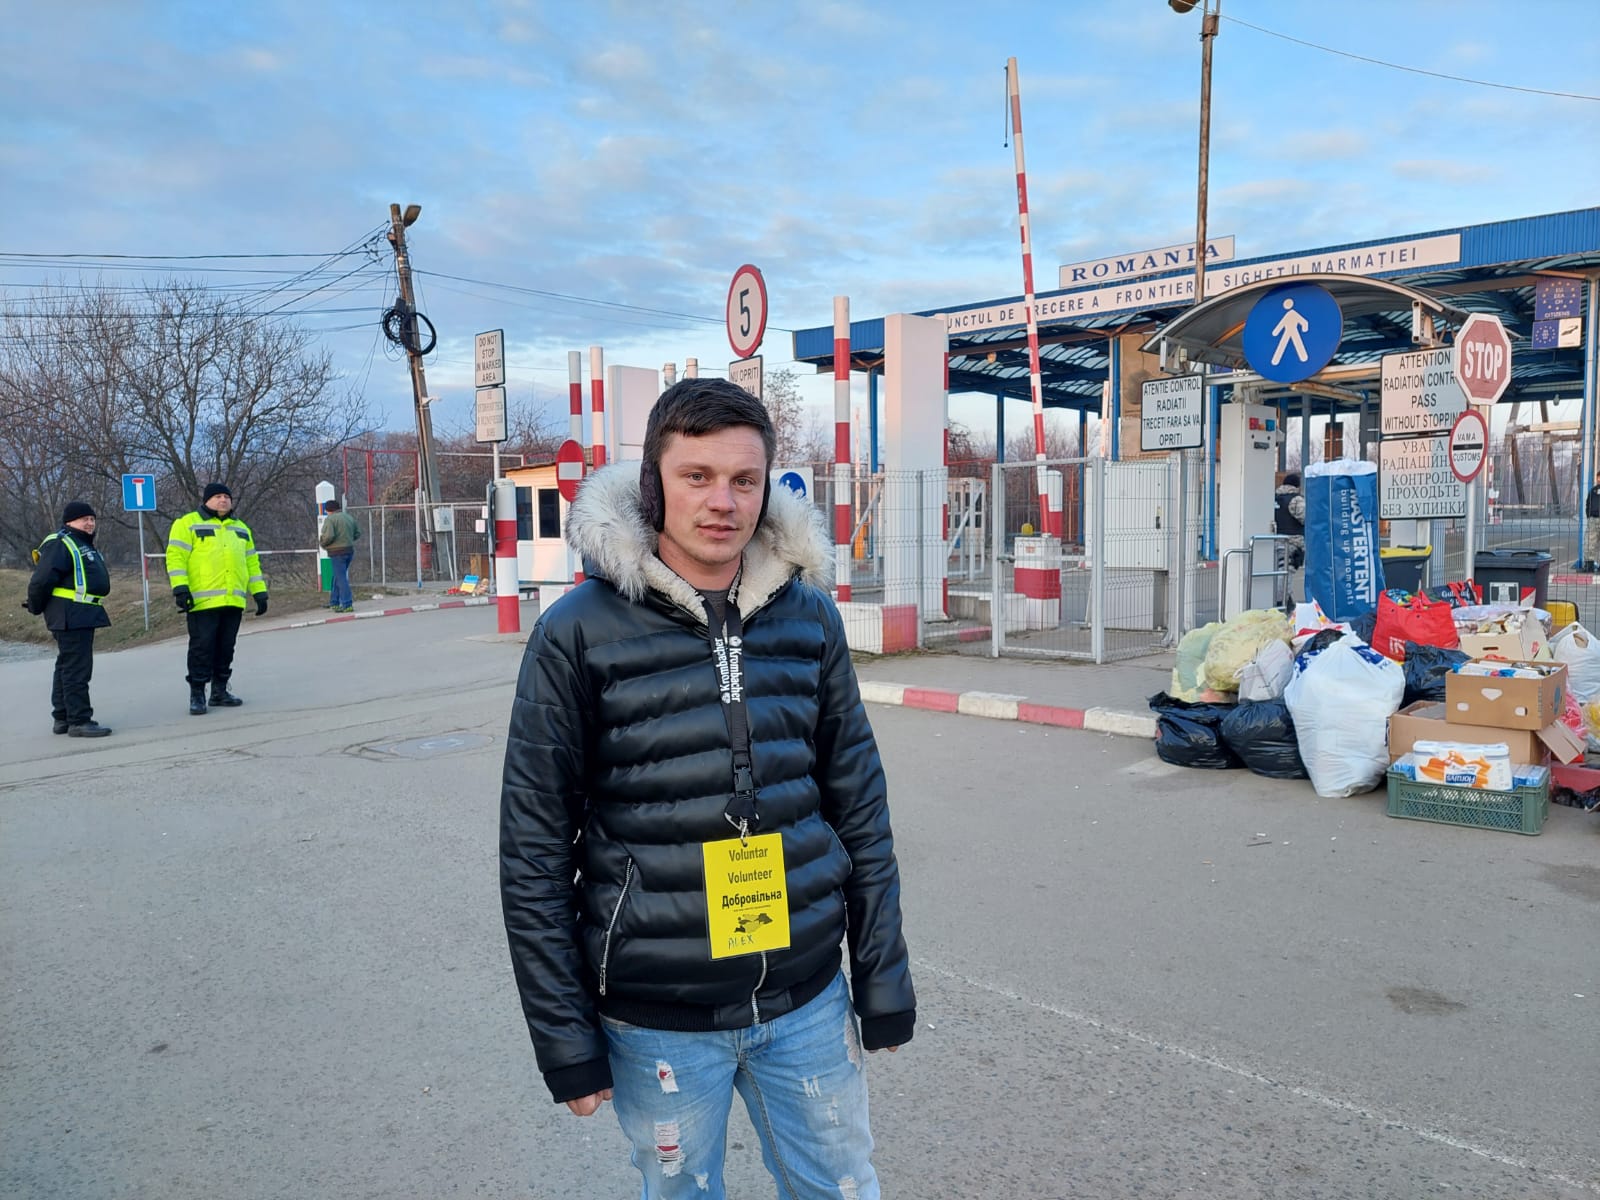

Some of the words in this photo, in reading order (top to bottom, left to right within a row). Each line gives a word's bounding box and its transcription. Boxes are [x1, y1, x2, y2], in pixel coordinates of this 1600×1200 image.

[1071, 243, 1221, 282] ROMANIA
[948, 311, 993, 329] UNCTUL
[1000, 308, 1014, 321] DE
[1025, 296, 1084, 316] RECERE
[1092, 295, 1099, 309] A
[1116, 279, 1211, 305] FRONTIERI
[739, 288, 750, 338] 5
[487, 335, 498, 345] NOT
[482, 347, 495, 359] STOP
[1400, 350, 1451, 370] ATTENTION
[1464, 340, 1503, 381] STOP
[482, 359, 501, 371] MARKED
[482, 372, 496, 382] AREA
[739, 366, 759, 382] OPRITI
[1384, 374, 1425, 392] RADIATION
[1428, 371, 1455, 387] CONTR
[1144, 381, 1169, 396] ATENTIE
[1170, 378, 1200, 392] CONTROL
[1156, 397, 1187, 412] RADIATII
[1411, 392, 1437, 408] PASS
[1143, 416, 1166, 430] TRECETI
[1167, 415, 1182, 428] FARA
[1183, 414, 1191, 427] SA
[1192, 413, 1200, 426] VA
[1384, 414, 1421, 431] WITHOUT
[1423, 412, 1460, 428] STOPPIN
[1159, 432, 1183, 446] OPRITI
[1457, 432, 1476, 441] VAMA
[1403, 439, 1444, 453] УВАГА
[1382, 454, 1450, 471] РАДІАЦІЙН
[1453, 452, 1481, 462] CUSTOMS
[1391, 471, 1456, 487] КОНТРОЛЬ
[1387, 484, 1461, 500] ПРОХОДЬТЕ
[1340, 489, 1351, 536] building
[1382, 503, 1402, 516] БЕЗ
[1407, 501, 1466, 516] ЗУПИНКИ
[1341, 540, 1351, 553] up
[1350, 488, 1370, 604] MASTERTENT
[1344, 558, 1354, 606] moments
[713, 637, 730, 692] Krombacher
[729, 648, 744, 703] Krombacher
[728, 847, 769, 861] Voluntar
[727, 869, 773, 884] Volunteer
[721, 890, 782, 909] Добровільна
[727, 934, 754, 950] ALEX
